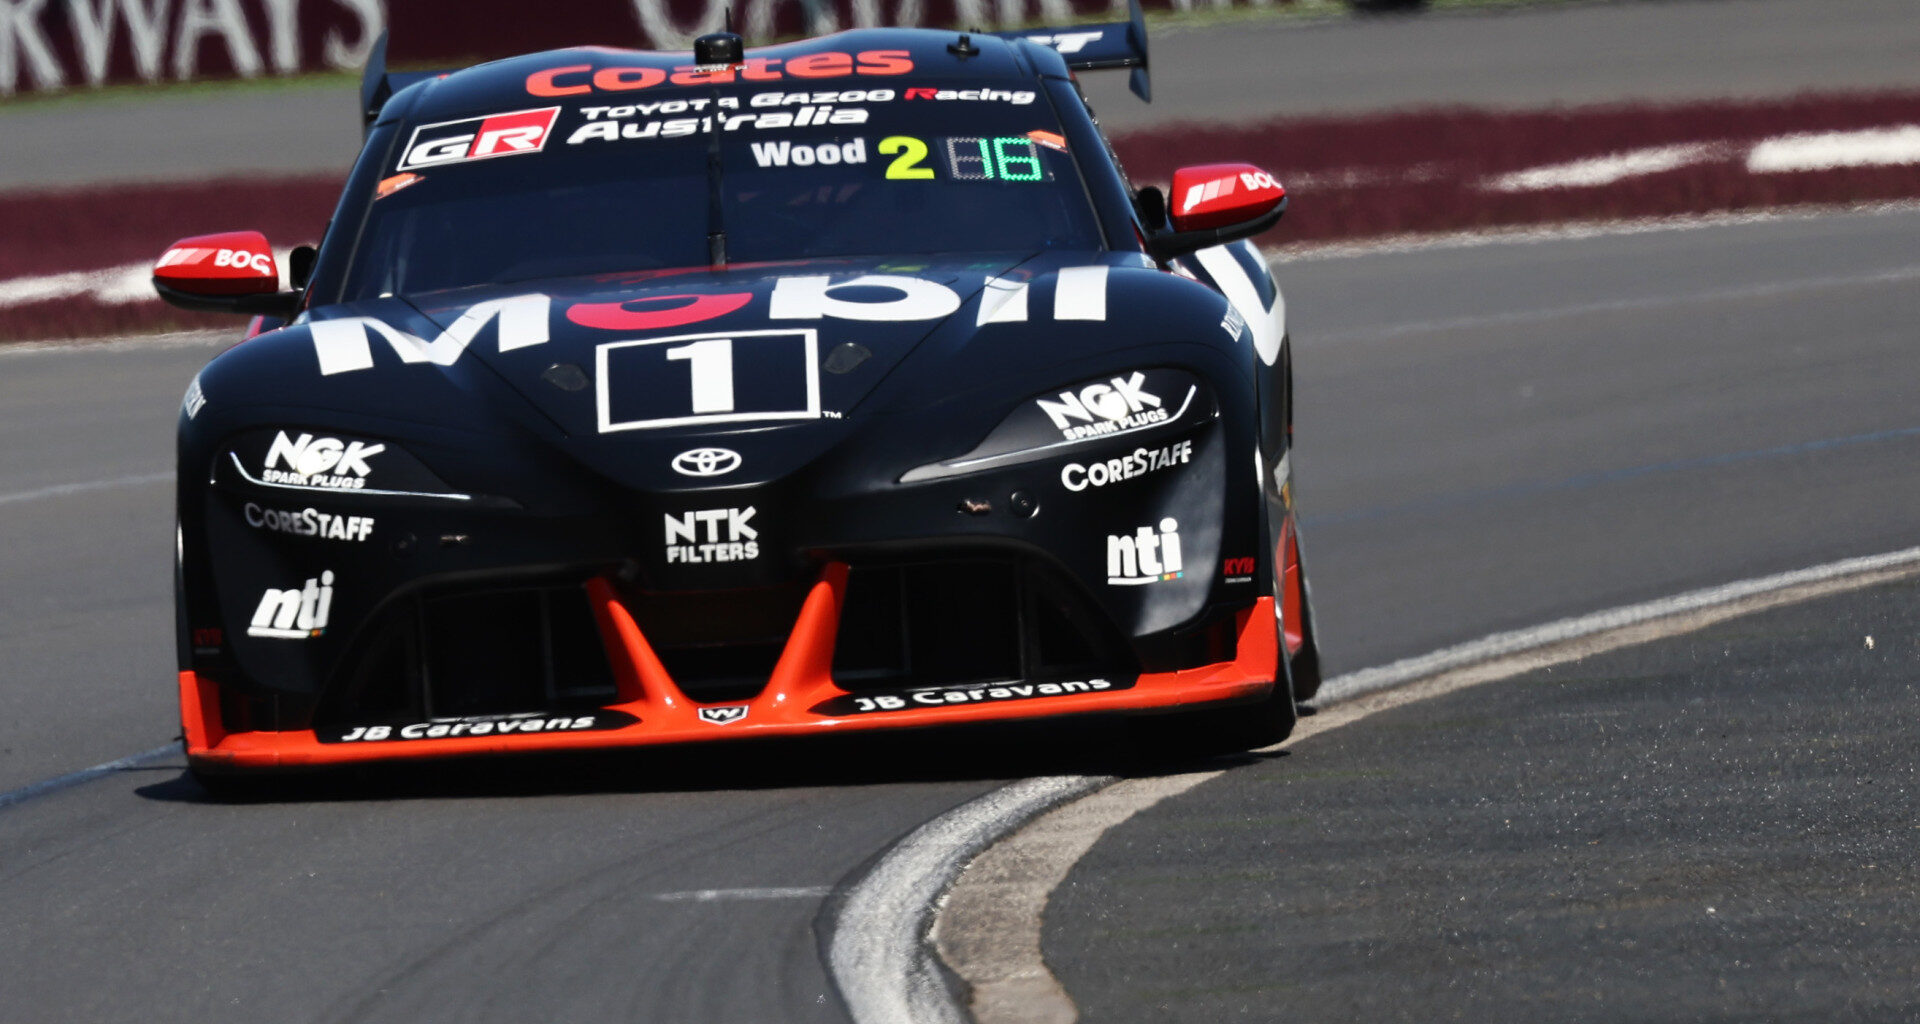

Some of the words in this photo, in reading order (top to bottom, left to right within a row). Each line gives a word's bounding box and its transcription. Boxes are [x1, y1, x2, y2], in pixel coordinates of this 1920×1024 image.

[525, 49, 914, 97] Coates
[580, 97, 739, 120] TOYOTA
[904, 88, 1035, 105] Racing
[566, 106, 869, 144] Australia
[407, 126, 545, 166] GR
[751, 137, 867, 168] Wood
[878, 136, 935, 180] 2
[310, 265, 1109, 375] Mobil
[667, 339, 734, 413] 1
[1036, 371, 1161, 430] NGK
[1063, 420, 1119, 440] SPARK
[1119, 408, 1168, 430] PLUGS
[264, 430, 386, 477] NGK
[262, 469, 308, 486] SPARK
[311, 474, 366, 489] PLUGS
[665, 505, 758, 544] NTK
[666, 542, 760, 563] FILTERS
[1107, 517, 1182, 578] nti
[252, 570, 334, 629] nti
[855, 695, 905, 711] JB
[912, 678, 1111, 704] Caravans
[341, 725, 392, 742] JB
[400, 716, 596, 739] Caravans
